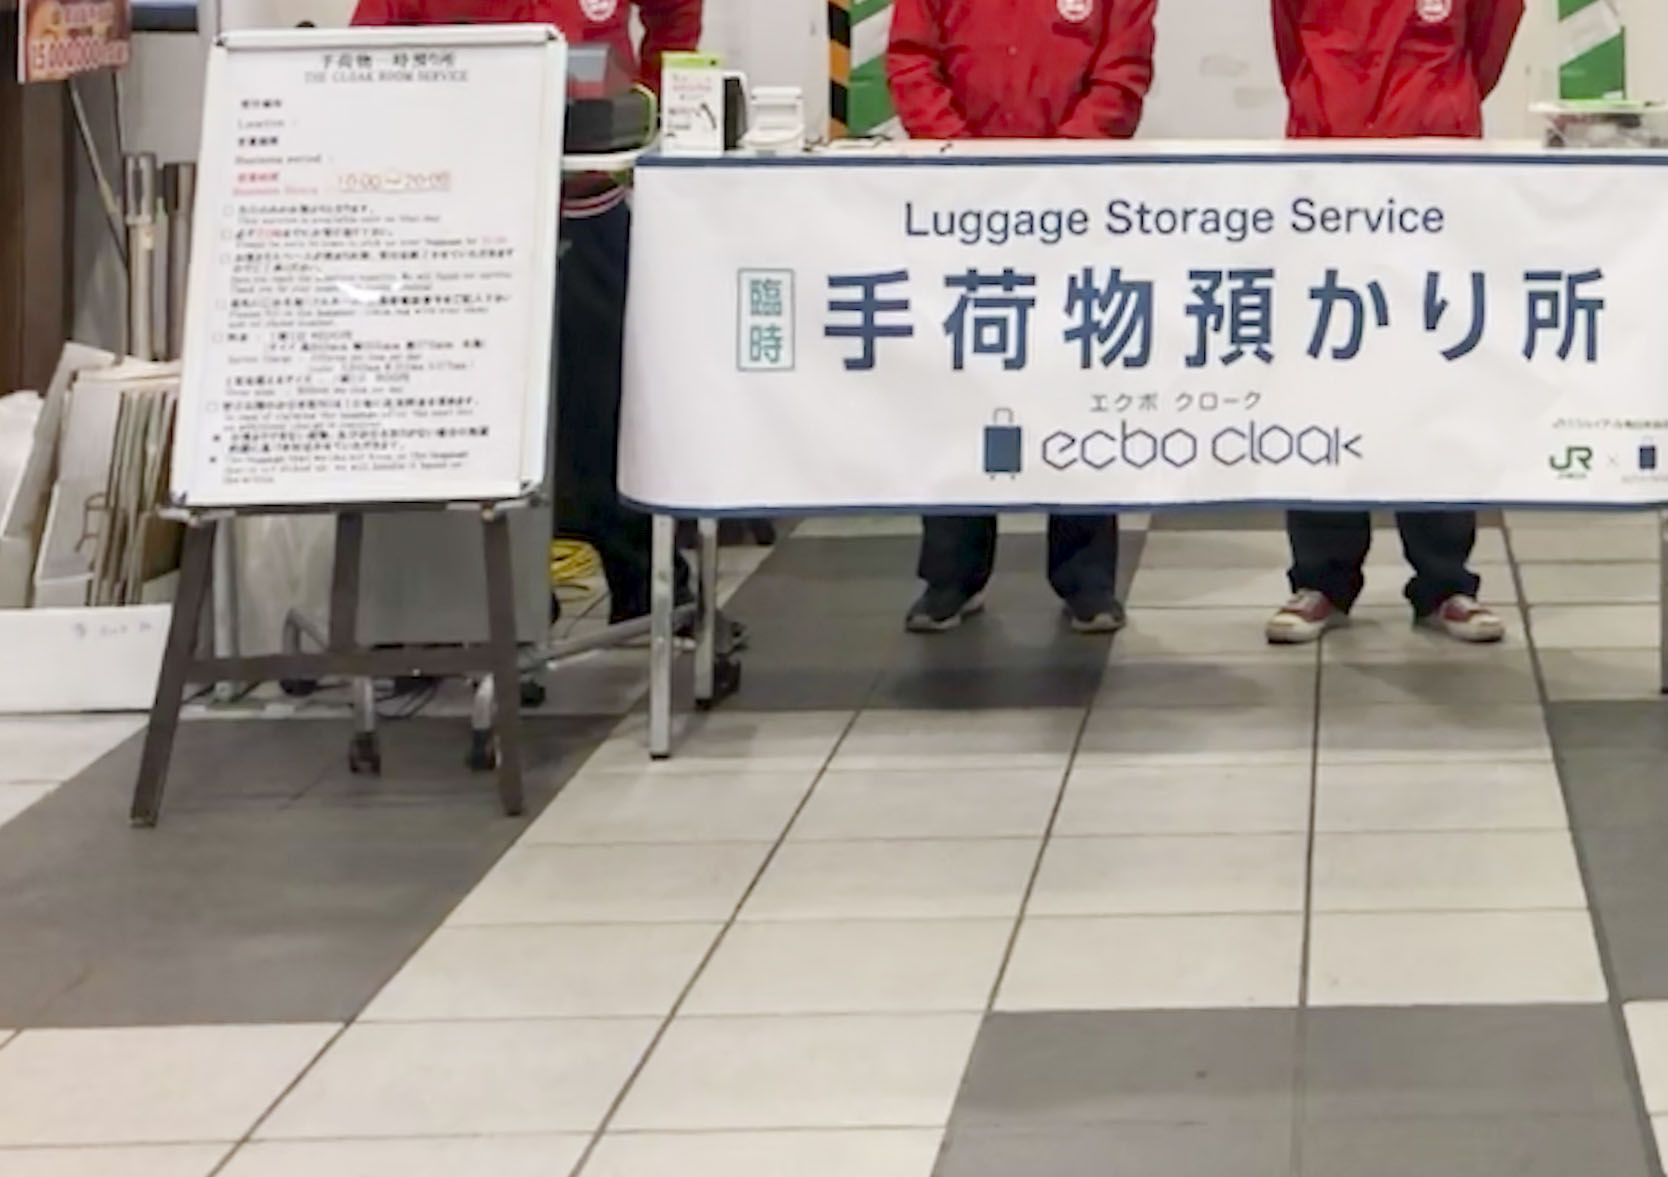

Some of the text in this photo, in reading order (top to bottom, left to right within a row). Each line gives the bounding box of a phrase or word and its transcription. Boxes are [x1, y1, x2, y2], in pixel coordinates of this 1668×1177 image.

[905, 198, 1444, 245] Luggage Storage Service
[750, 267, 1605, 370] 臨時 手荷物預かり所
[1175, 390, 1262, 411] クローク
[1042, 420, 1363, 471] ecbo cloak
[1549, 445, 1593, 470] JR
